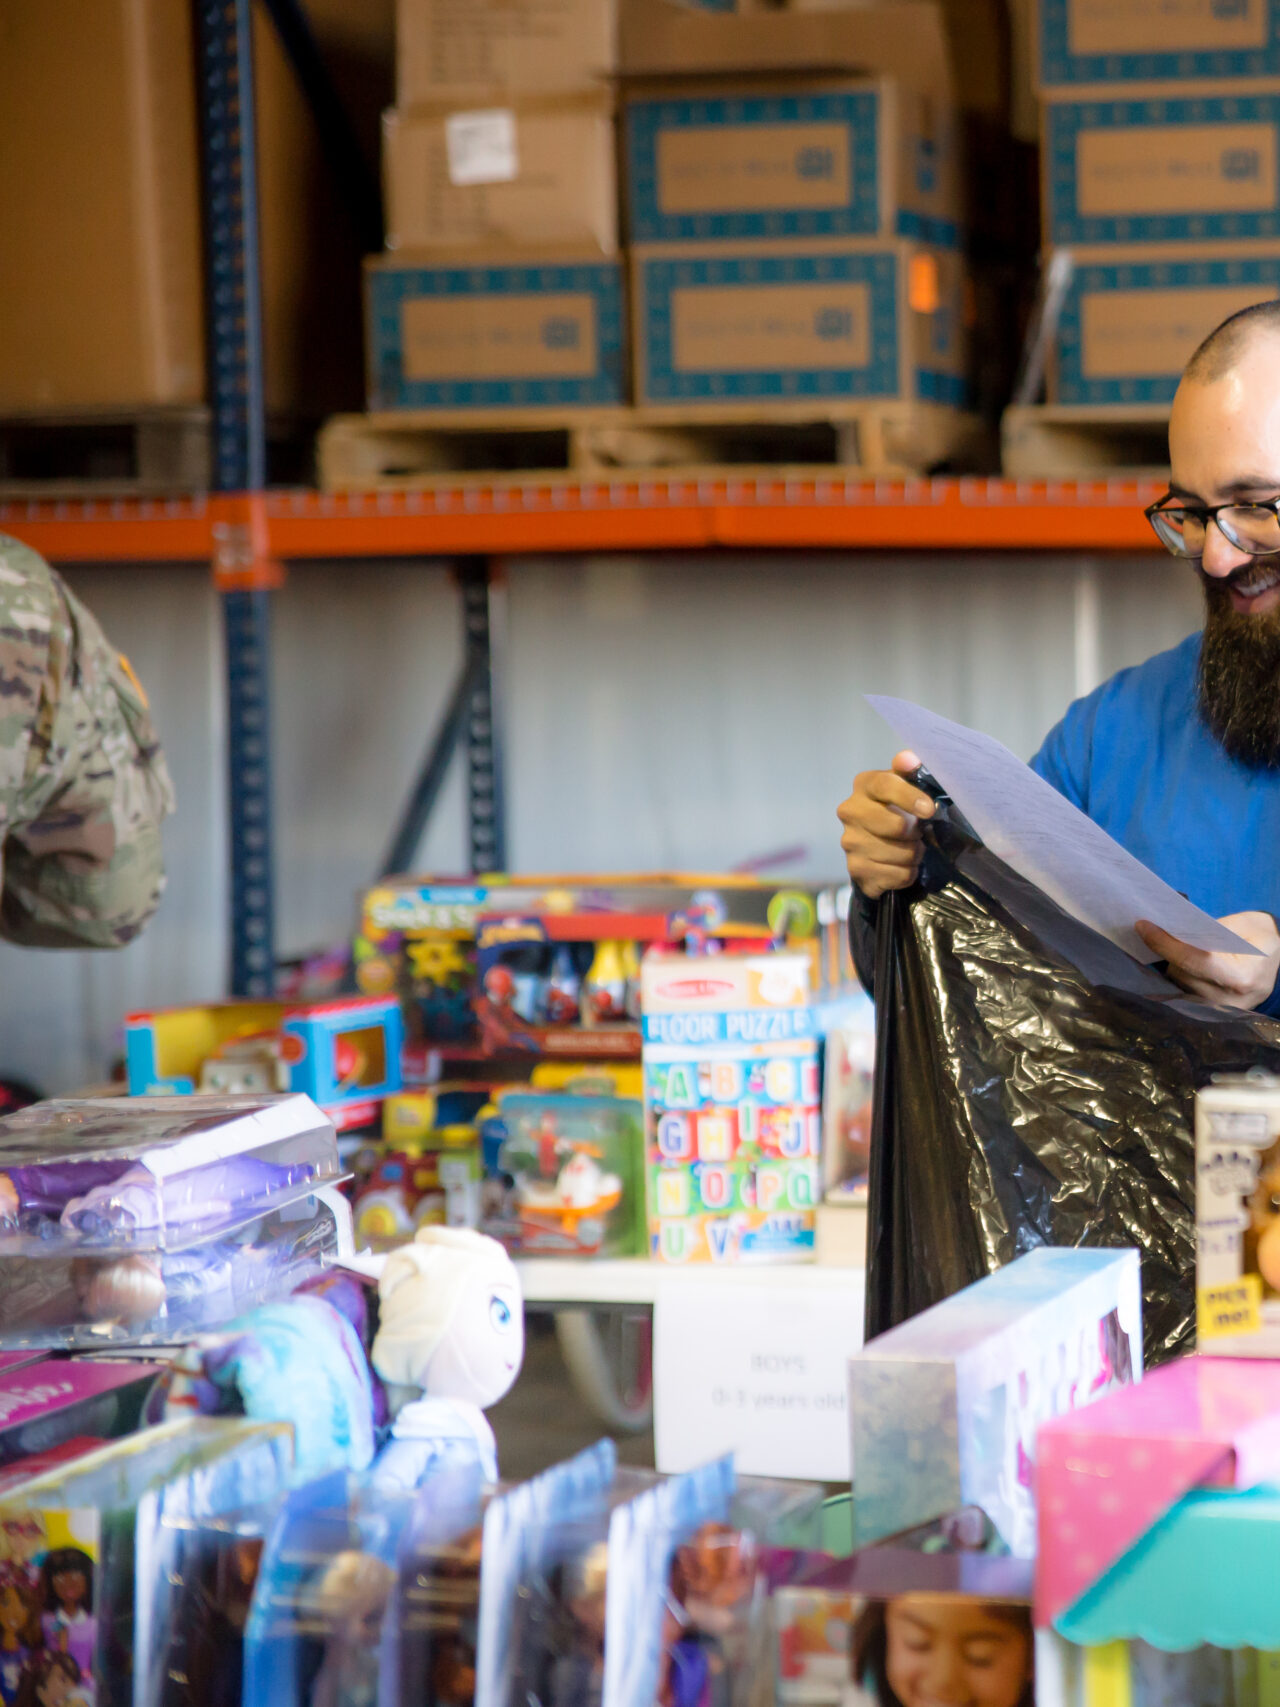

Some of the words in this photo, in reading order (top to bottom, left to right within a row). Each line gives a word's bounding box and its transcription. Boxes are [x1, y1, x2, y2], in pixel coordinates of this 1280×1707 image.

[646, 1012, 718, 1044] FLOOR
[751, 1354, 806, 1374] BOYS
[752, 1393, 808, 1412] years
[813, 1391, 846, 1409] old
